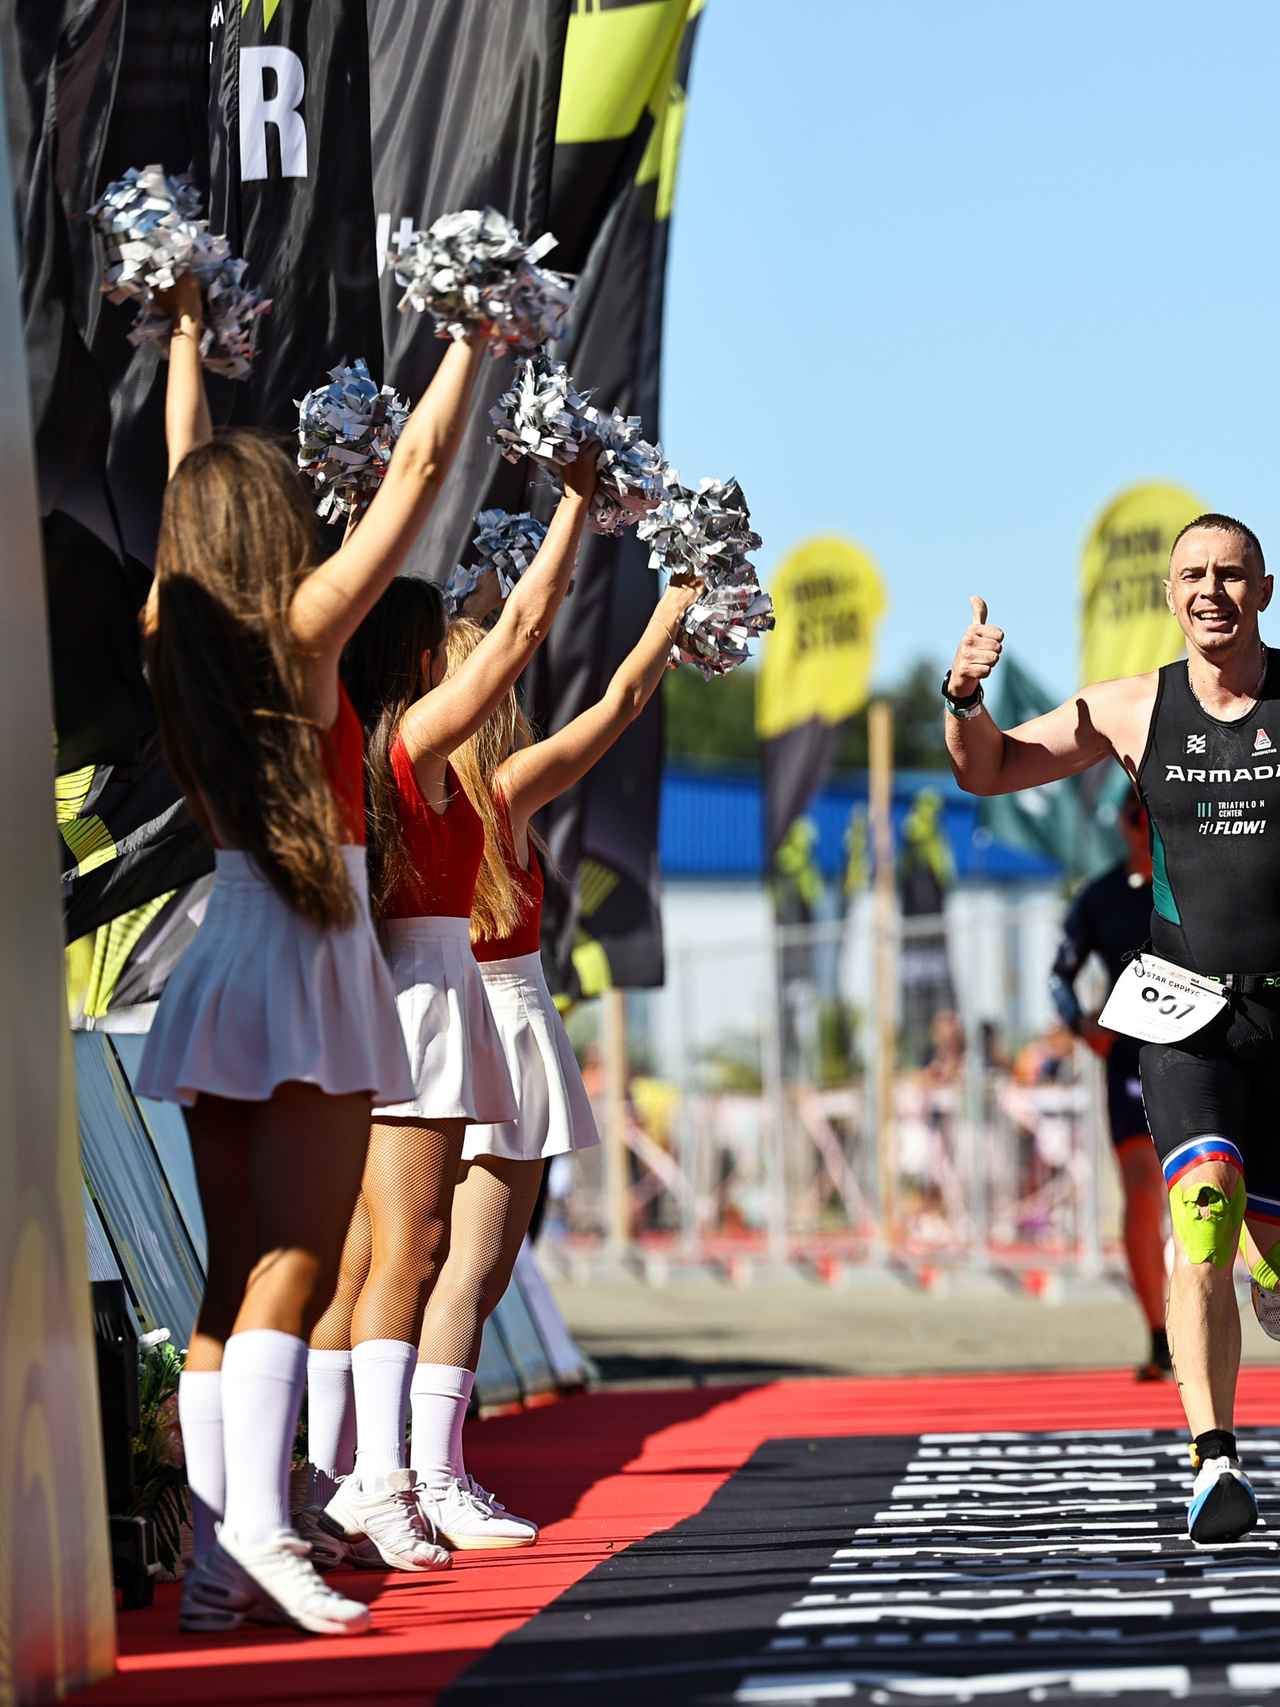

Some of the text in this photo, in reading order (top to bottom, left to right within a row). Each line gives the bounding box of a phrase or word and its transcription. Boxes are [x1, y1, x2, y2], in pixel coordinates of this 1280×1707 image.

[1217, 799, 1265, 810] TRIATHLON
[1218, 809, 1243, 818] CENTER
[1168, 980, 1201, 998] СИРИУС
